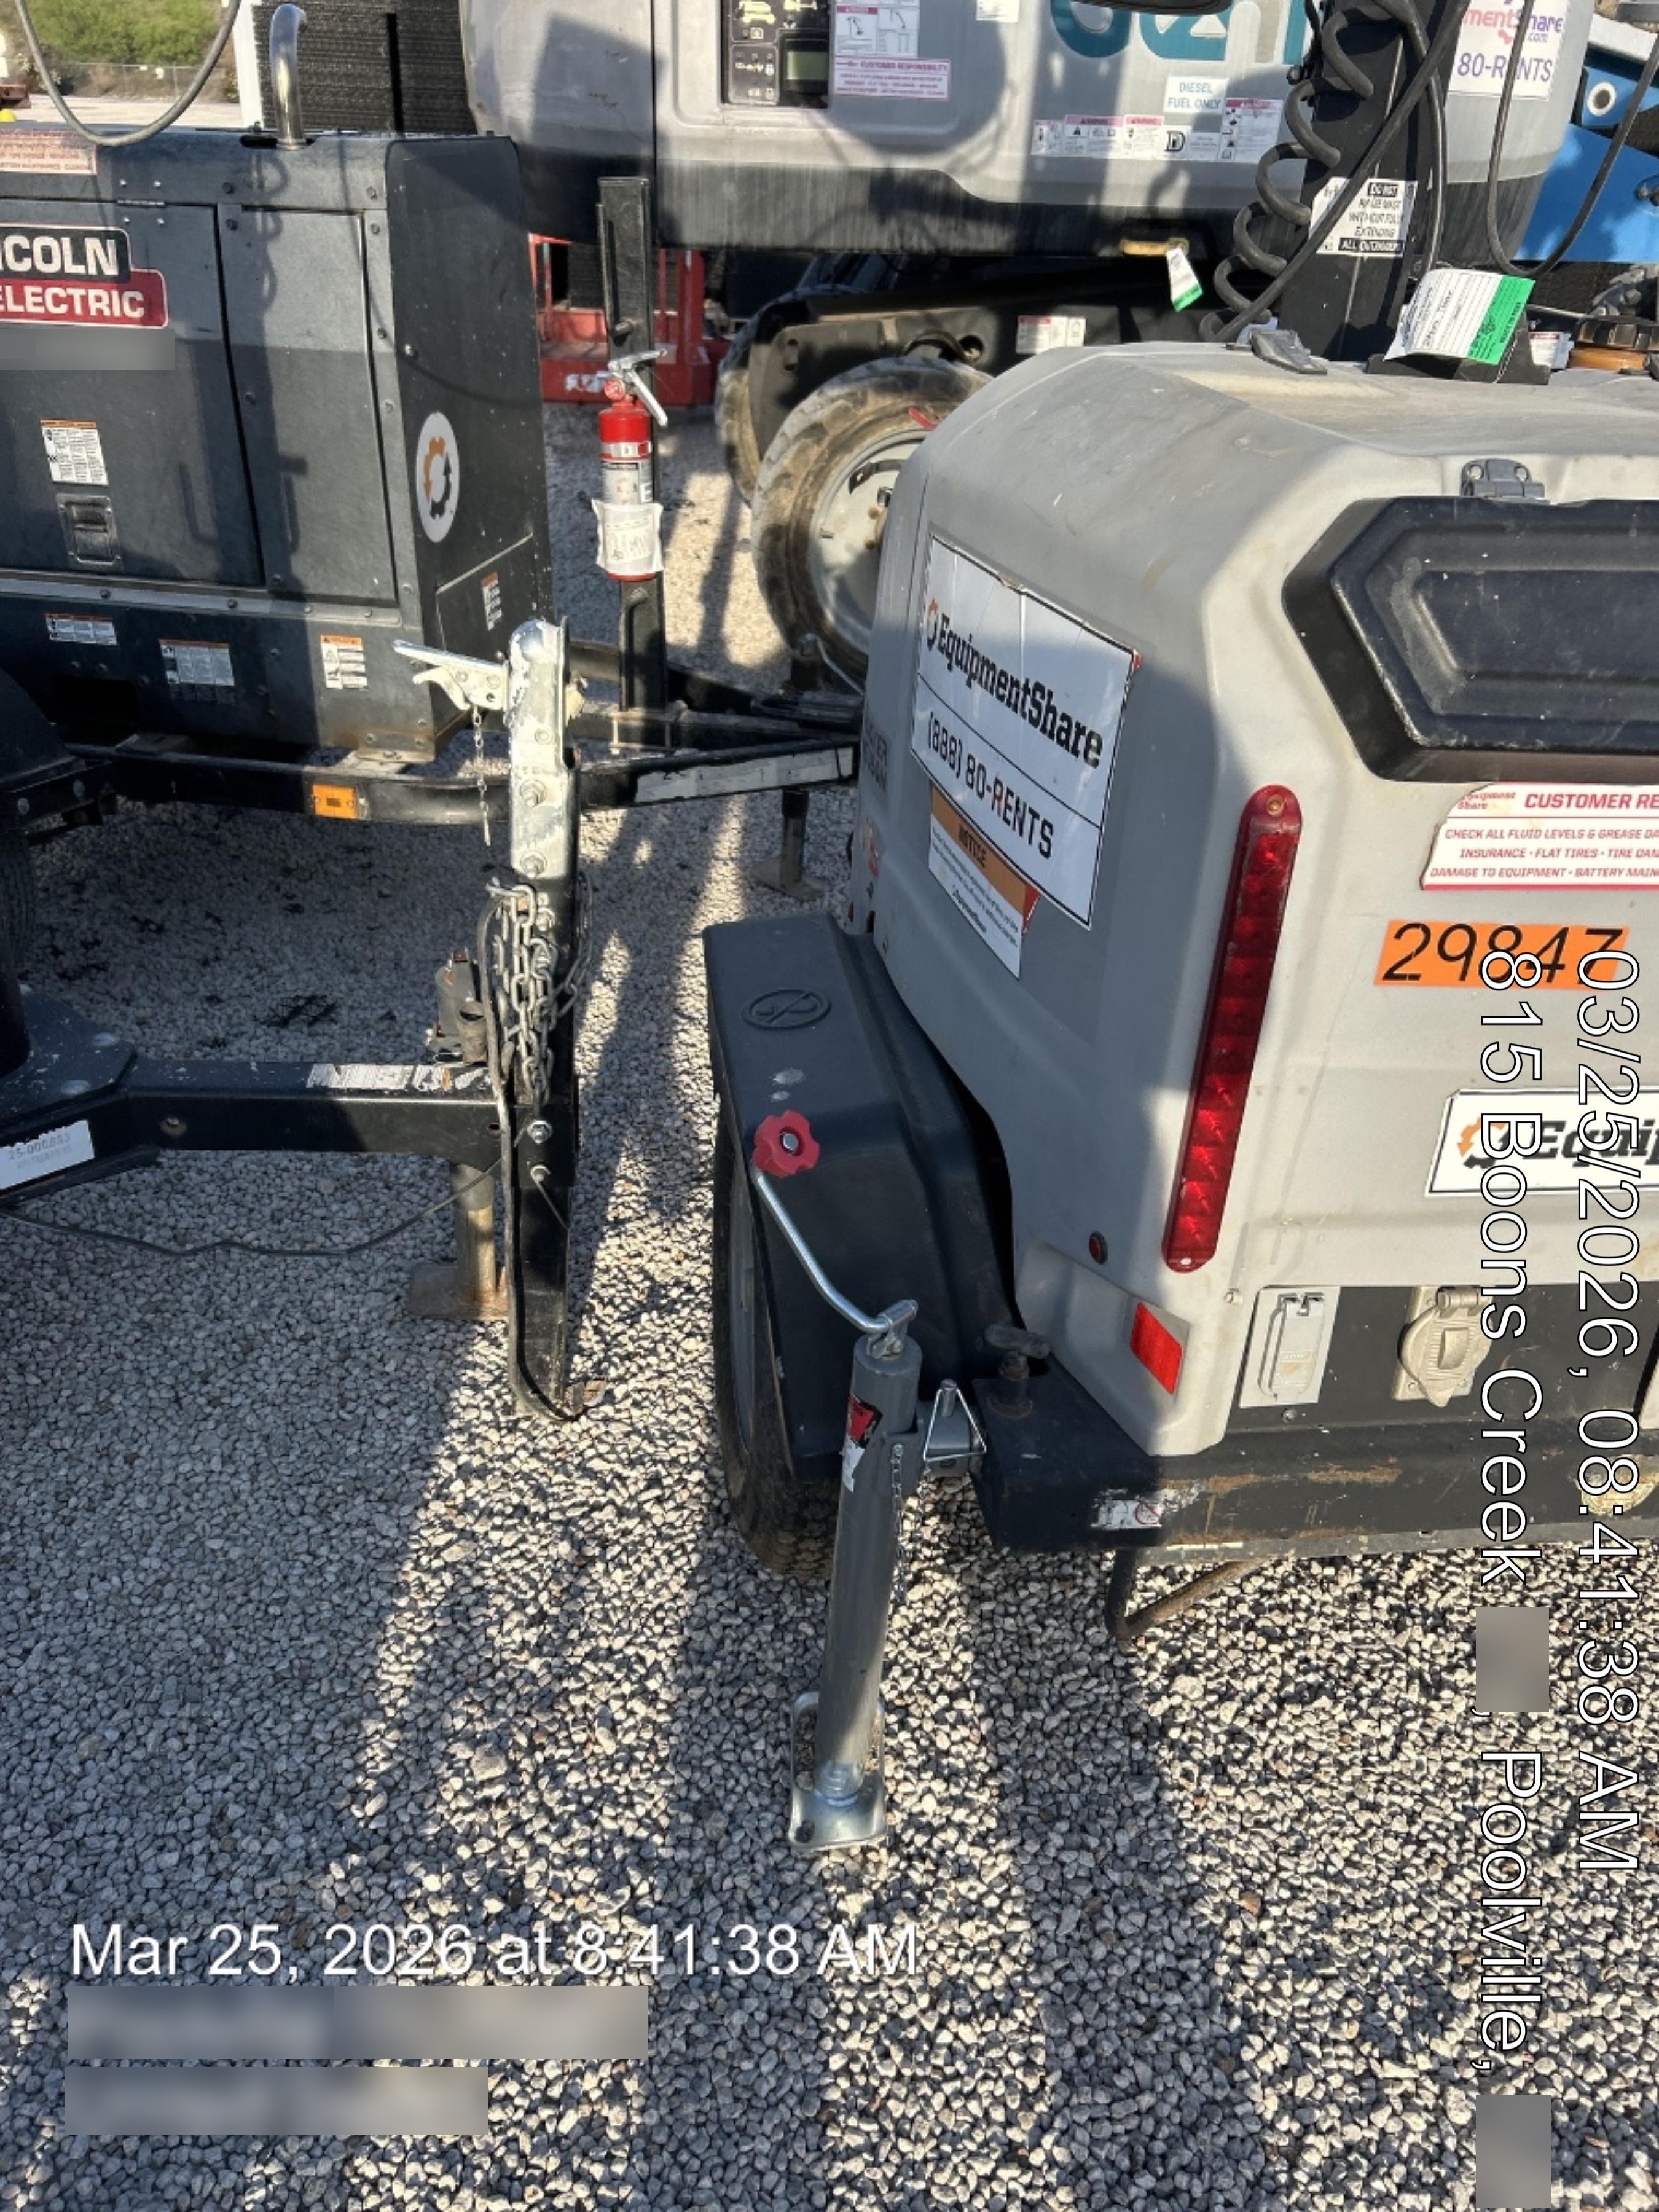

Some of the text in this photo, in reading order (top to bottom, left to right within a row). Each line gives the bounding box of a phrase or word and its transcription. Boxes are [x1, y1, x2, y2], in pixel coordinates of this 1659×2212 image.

[1457, 52, 1553, 82] 80-RNTS
[1179, 82, 1214, 93] DIESEL
[1167, 98, 1222, 109] FUEL ONLY
[0, 235, 119, 275] COLN
[938, 613, 1103, 769] EquipmentShare
[928, 710, 963, 779] (888)
[965, 753, 1054, 860] 80-RENTS
[1524, 793, 1633, 809] CUSTOMER
[1635, 793, 1659, 810] RE
[1445, 828, 1484, 839] CHECK
[1486, 828, 1505, 839] ALL
[1508, 828, 1542, 839] FLUID
[1544, 828, 1586, 840] LEVELS
[1598, 828, 1643, 840] GREASE
[1459, 847, 1528, 858] INSURANCE
[1535, 847, 1562, 858] FLAT
[1565, 847, 1599, 858] TIRES
[1608, 847, 1633, 858] TIRE
[1430, 867, 1480, 878] DAMAGE
[1482, 867, 1496, 877] TO
[1498, 867, 1567, 878] EQUIPMENT
[1574, 867, 1625, 878] BATTERY
[1382, 922, 1624, 985] 29847
